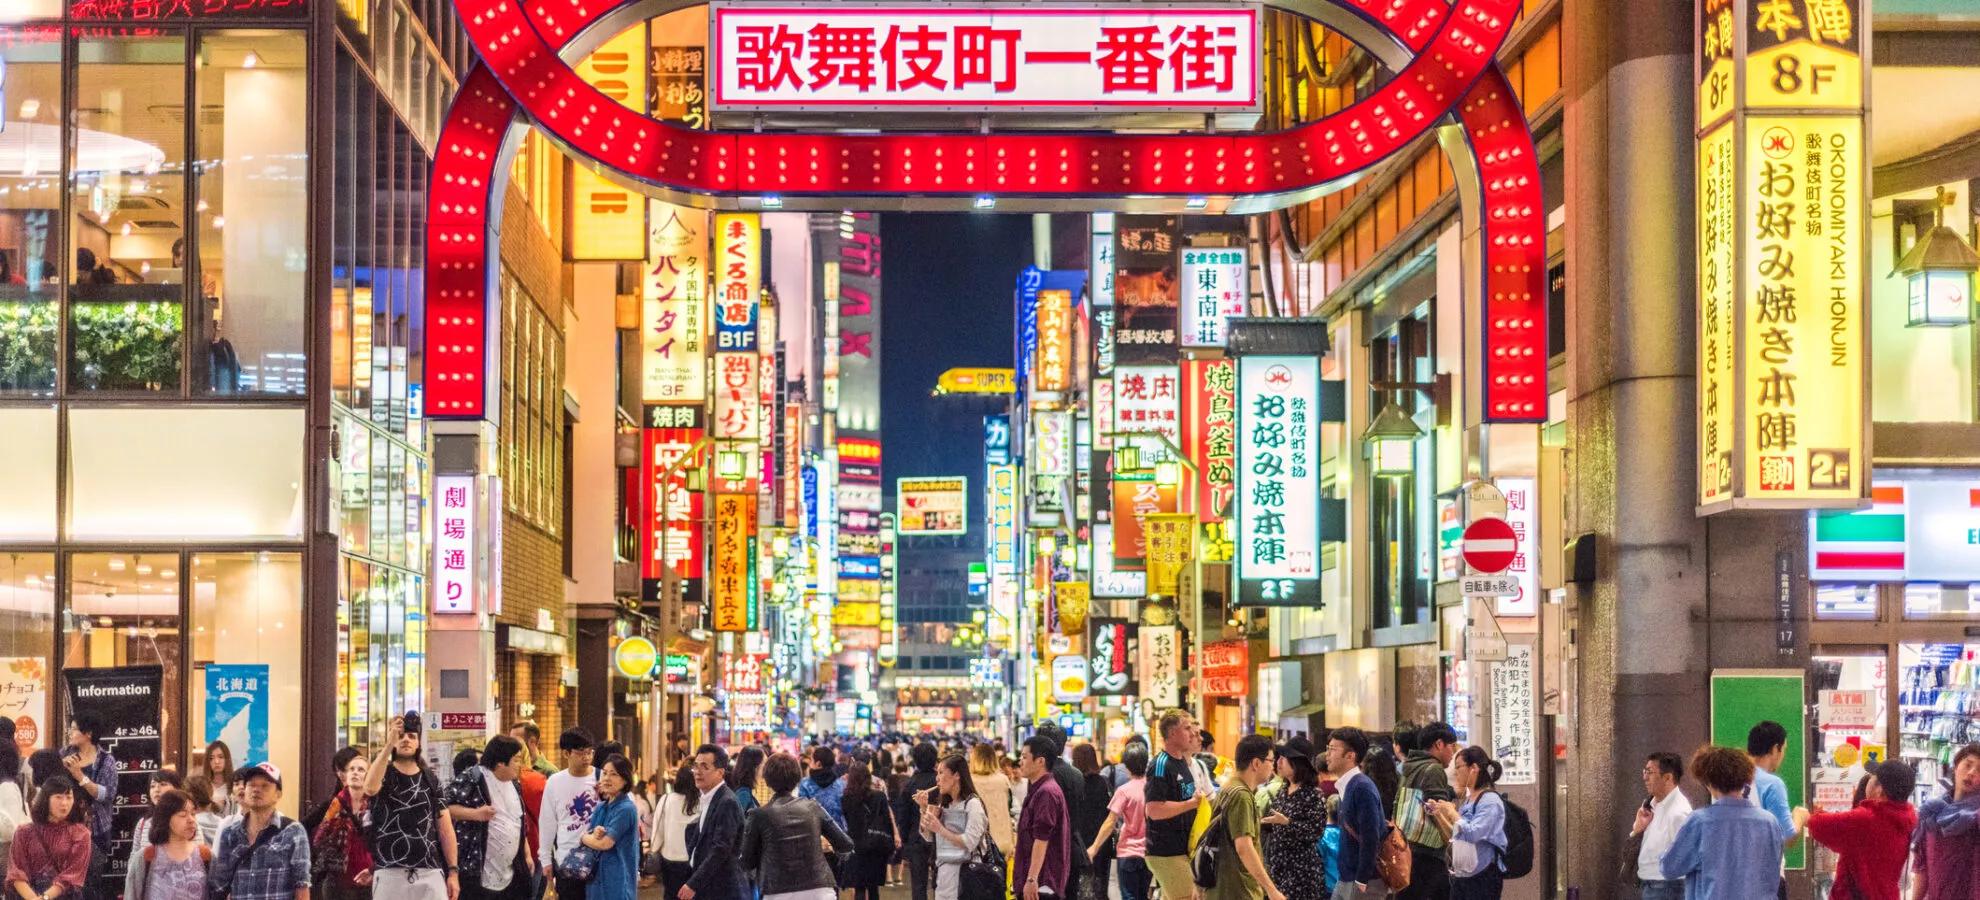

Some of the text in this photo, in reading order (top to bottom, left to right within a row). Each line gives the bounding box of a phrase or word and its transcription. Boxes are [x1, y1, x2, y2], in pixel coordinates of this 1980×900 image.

[736, 23, 1237, 93] 歌舞伎町一番街
[1772, 55, 1837, 95] 8F
[1710, 71, 1729, 111] 8F
[1805, 133, 1823, 237] 歌舞伎町名物
[1829, 133, 1847, 368] OKONOMIYAKI HONJIN
[727, 220, 749, 324] まぐろ商店
[651, 255, 680, 360] バンタイ
[1198, 267, 1218, 344] 東南荘
[1706, 178, 1718, 462] お好み焼き本陣
[1756, 162, 1798, 452] お好み焼き本陣
[719, 331, 755, 349] B1F
[661, 384, 685, 397] 3F
[652, 406, 695, 428] 焼肉
[1206, 363, 1234, 518] 焼鳥釜めし
[1252, 393, 1287, 566] お好み焼本陣
[1810, 454, 1850, 486] 2F
[443, 486, 474, 608] 劇場通り
[1261, 579, 1297, 600] 2F
[1464, 580, 1515, 593] 自転車を除く
[1781, 630, 1793, 642] 17
[0, 682, 34, 696] チョコ
[78, 684, 151, 701] information
[215, 677, 257, 691] 北海道
[1508, 656, 1521, 761] 防犯カメラ作動中
[115, 728, 128, 737] 4F
[116, 763, 129, 772] 3F
[116, 796, 129, 805] 2F
